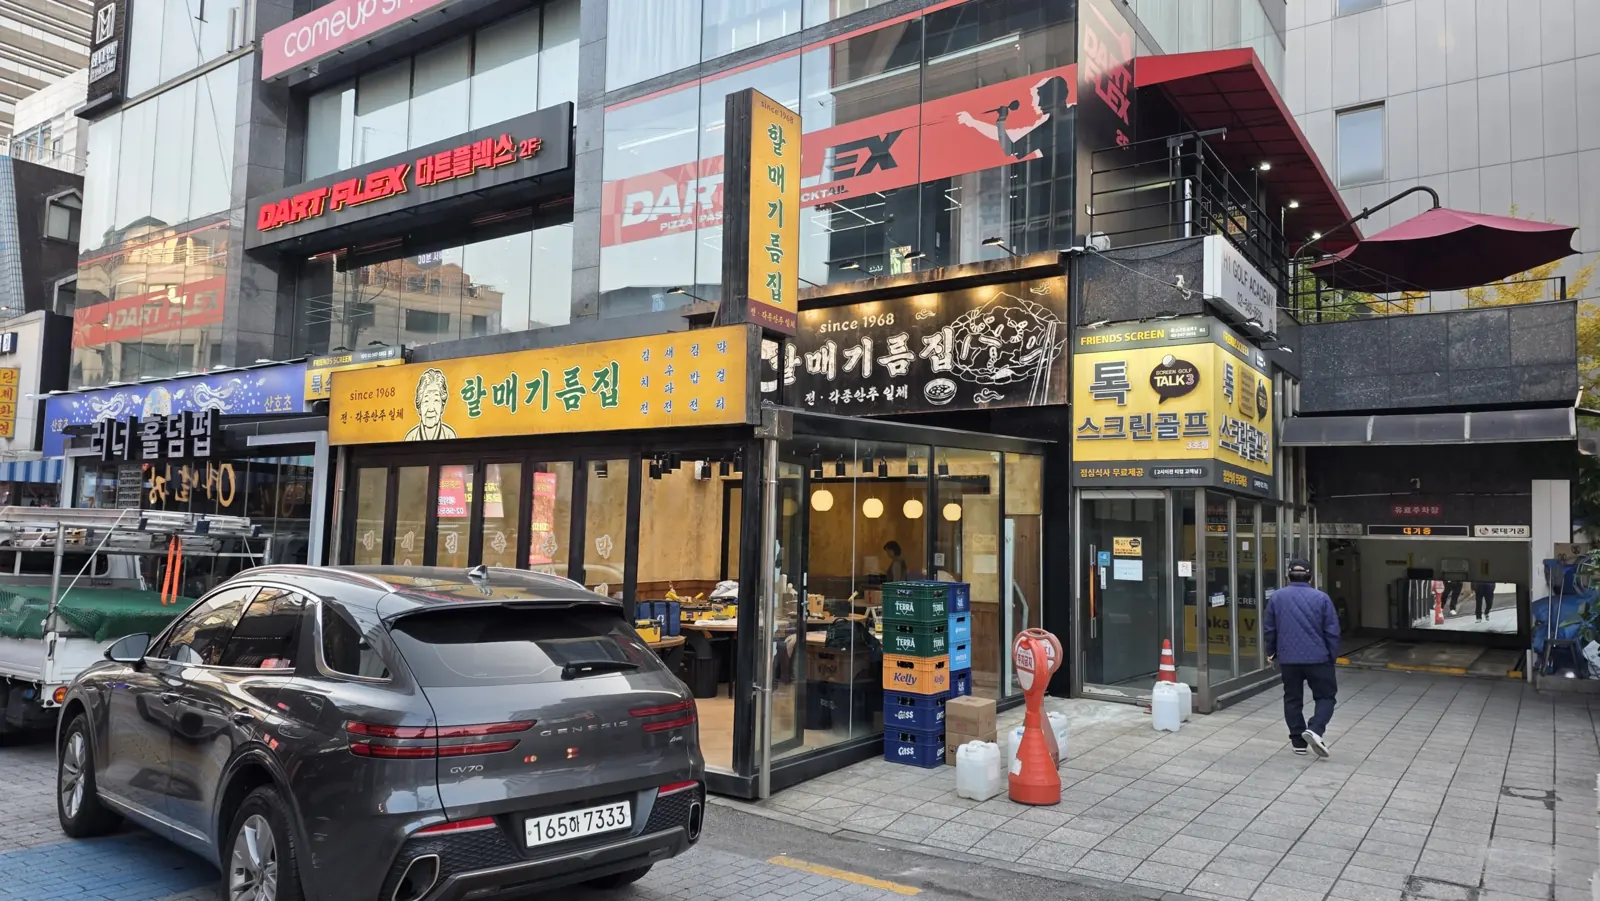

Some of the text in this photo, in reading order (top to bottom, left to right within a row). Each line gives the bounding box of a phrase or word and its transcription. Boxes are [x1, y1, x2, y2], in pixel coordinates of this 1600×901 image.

[1084, 23, 1132, 97] DART
[1084, 54, 1132, 126] FLEX
[761, 99, 794, 125] since 1968
[256, 133, 542, 232] DART FLEX 다트플렉스 2F
[621, 128, 904, 228] DAR EX
[660, 185, 849, 232] PIZZA PAS CKTAIL
[764, 122, 786, 303] 할매기름집
[1233, 259, 1248, 287] GOLF
[1249, 275, 1274, 311] ACADEMY
[114, 303, 164, 331] DART
[168, 288, 220, 320] FLEX
[819, 312, 895, 334] since 1968
[1080, 333, 1122, 346] FRIENDS
[1124, 328, 1165, 342] SCREEN
[313, 355, 352, 367] FRIENDS SCREEN
[640, 348, 650, 415] 김치전
[663, 345, 674, 413] 새우파전
[689, 343, 701, 412] 김밥전
[716, 340, 727, 410] 막걸리
[1089, 360, 1131, 406] 톡
[1223, 360, 1234, 405] 톡
[350, 387, 396, 401] since 1968
[458, 359, 621, 420] 할매기름집
[804, 384, 909, 406] 전 각종안주 일체
[264, 394, 293, 412] 산호초
[340, 407, 404, 424] 전 각종안주 일체
[1076, 411, 1211, 441] 스크린골프
[139, 408, 219, 460] 홀덤펍
[1219, 414, 1264, 463] 스크린골프
[1079, 468, 1110, 479] 점심식사
[1112, 467, 1144, 478] 무료제공
[1394, 506, 1440, 515] 유료주차장
[1402, 526, 1432, 535] 대기중
[1491, 527, 1525, 535] 롯데기공
[894, 600, 915, 612] TERRA
[932, 601, 945, 612] TERRA
[895, 636, 916, 648] TERRA
[932, 637, 945, 648] TERRA
[1017, 653, 1033, 669] 주차금지
[893, 672, 917, 686] Kelly
[897, 710, 914, 720] Cass
[540, 720, 629, 737] GENESIS
[898, 746, 915, 756] Cass
[450, 764, 484, 774] GV70
[533, 804, 626, 842] 165하 7333
